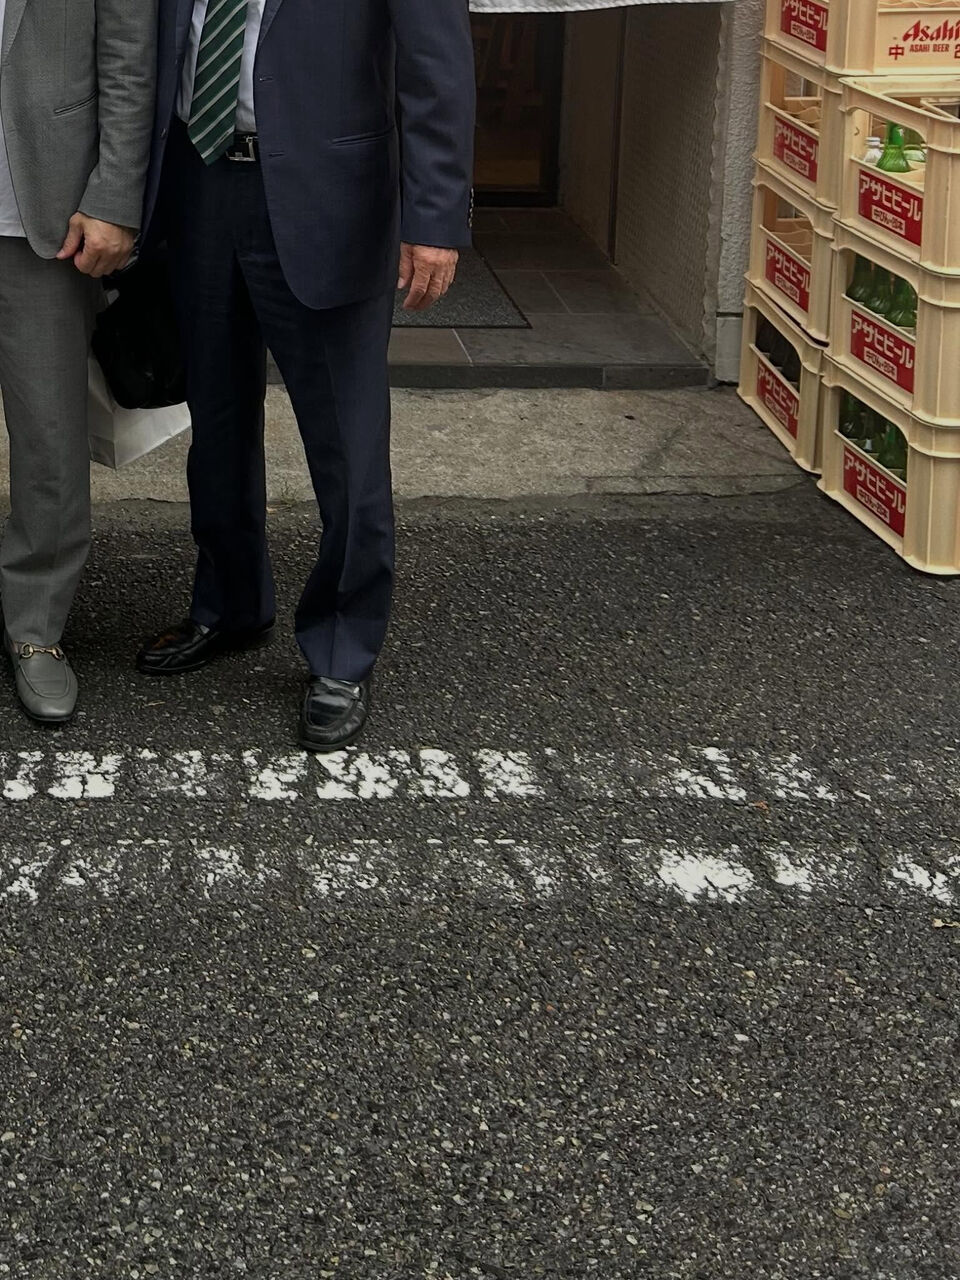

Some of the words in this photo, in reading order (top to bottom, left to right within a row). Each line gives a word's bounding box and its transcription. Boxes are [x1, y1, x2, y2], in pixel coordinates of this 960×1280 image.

[888, 44, 905, 61] 中
[909, 44, 930, 53] ASAHI
[932, 43, 950, 53] BEER
[902, 19, 960, 42] Asahi
[860, 173, 922, 222] アサヒビール
[852, 313, 914, 369] アサヒビール
[845, 450, 906, 514] アサヒビール
